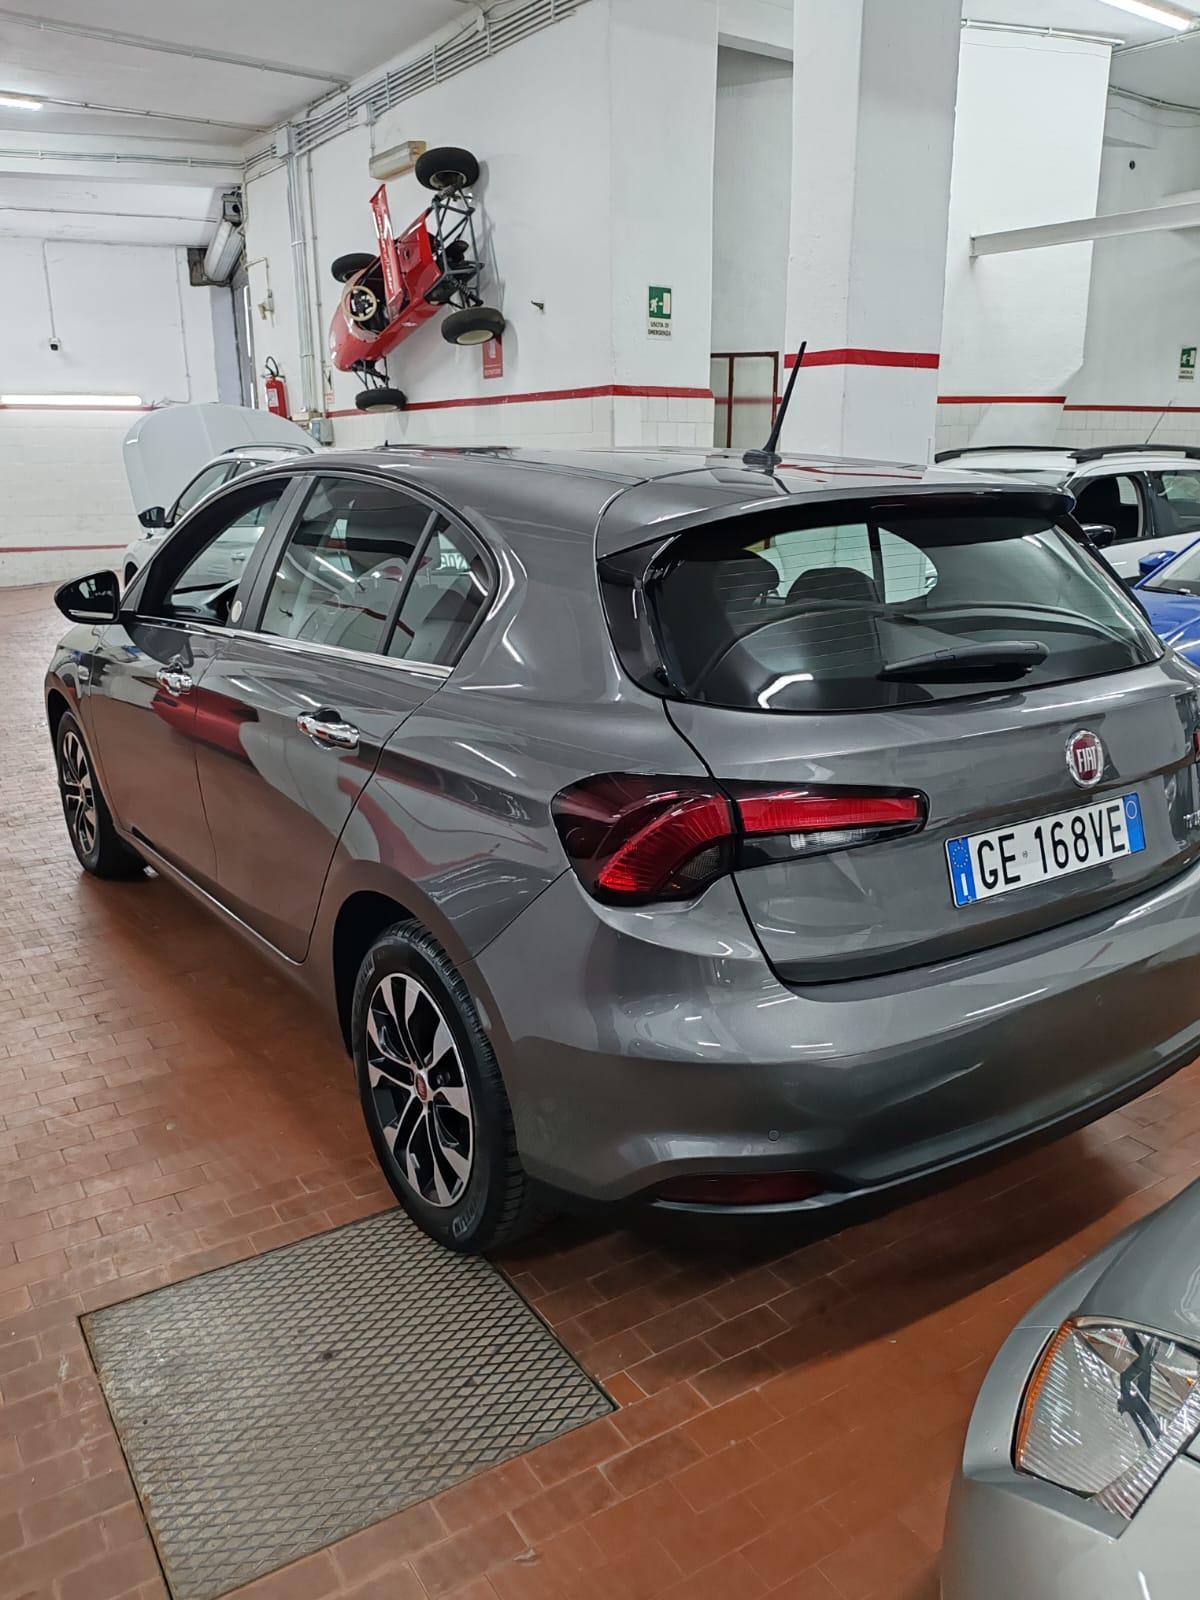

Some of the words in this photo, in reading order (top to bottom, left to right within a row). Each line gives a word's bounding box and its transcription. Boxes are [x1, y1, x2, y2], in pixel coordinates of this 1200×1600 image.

[1076, 746, 1098, 773] FIAT
[976, 832, 1021, 890] GE
[1034, 805, 1125, 874] 168VE
